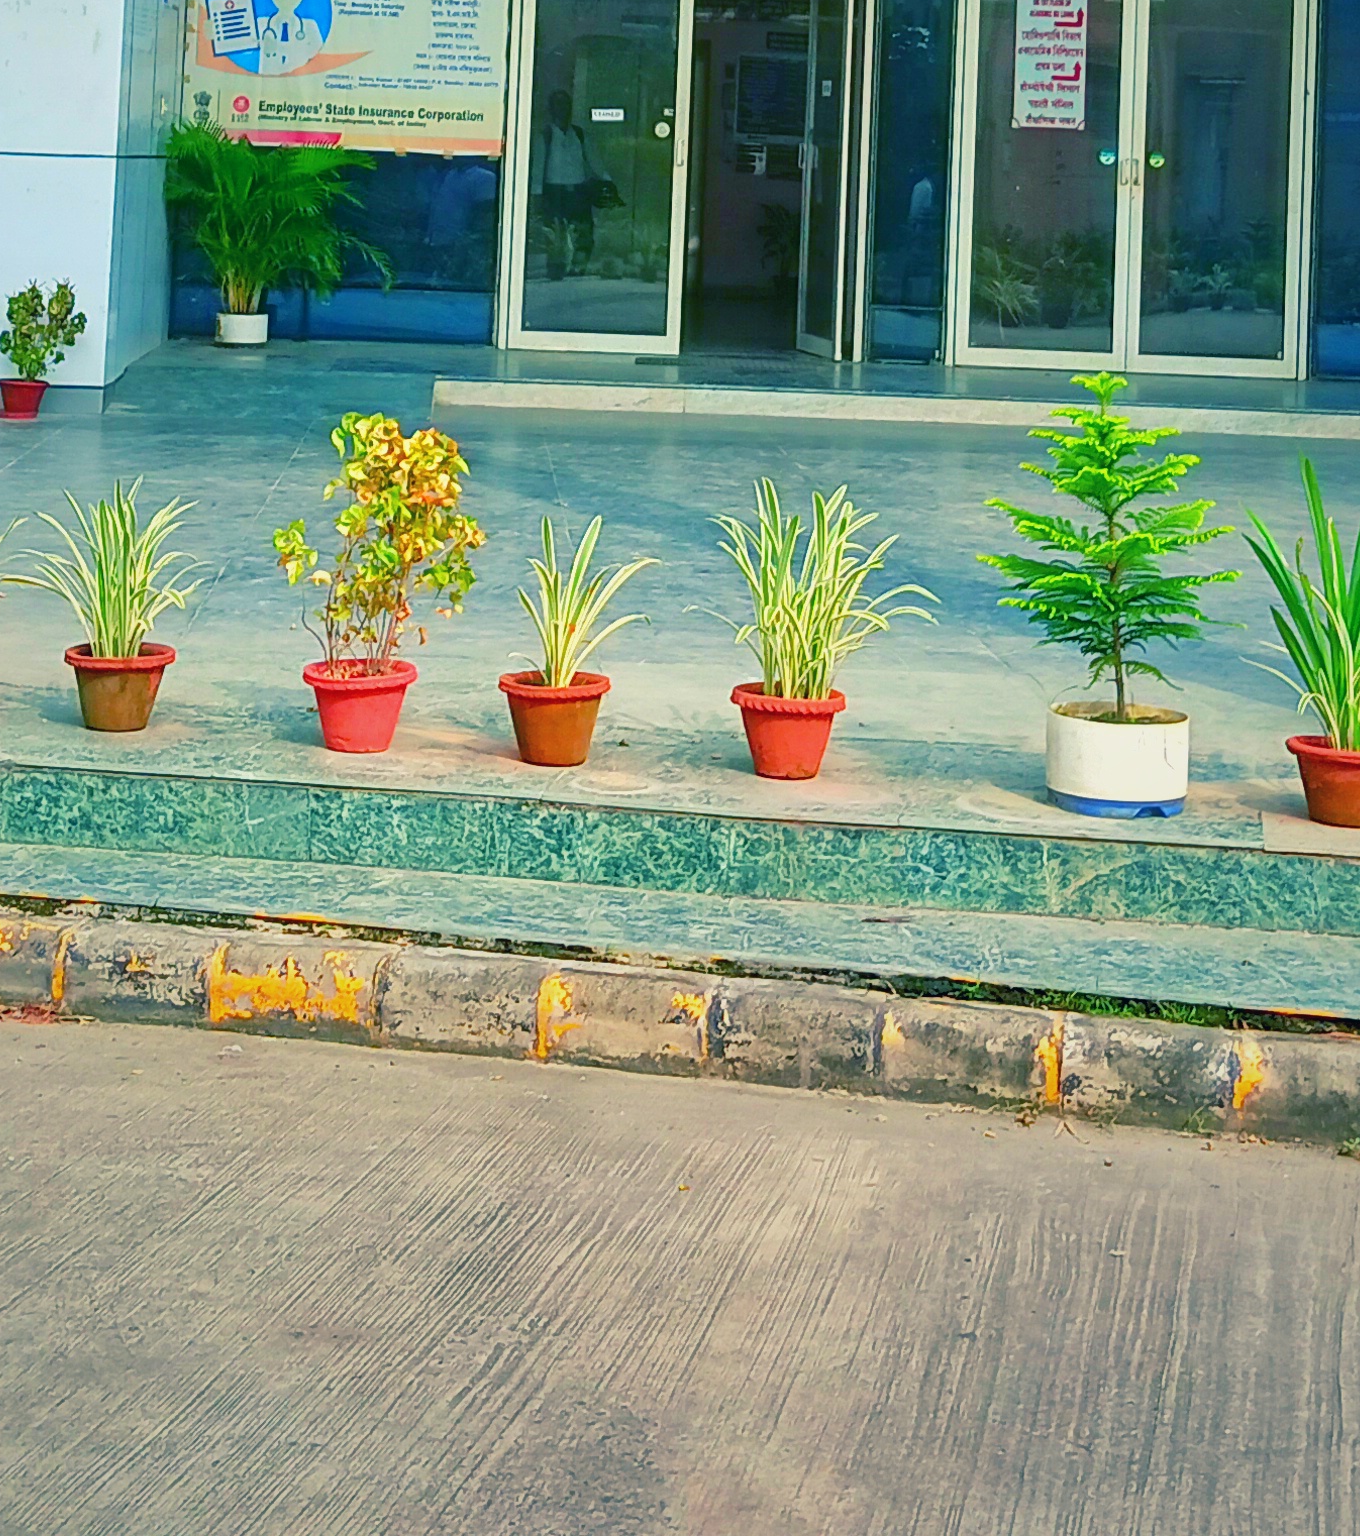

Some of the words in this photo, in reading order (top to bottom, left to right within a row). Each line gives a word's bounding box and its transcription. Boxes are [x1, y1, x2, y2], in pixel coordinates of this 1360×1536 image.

[258, 100, 323, 115] Employees'
[325, 103, 356, 116] State
[358, 104, 415, 119] Insurance
[418, 107, 484, 122] Corporation
